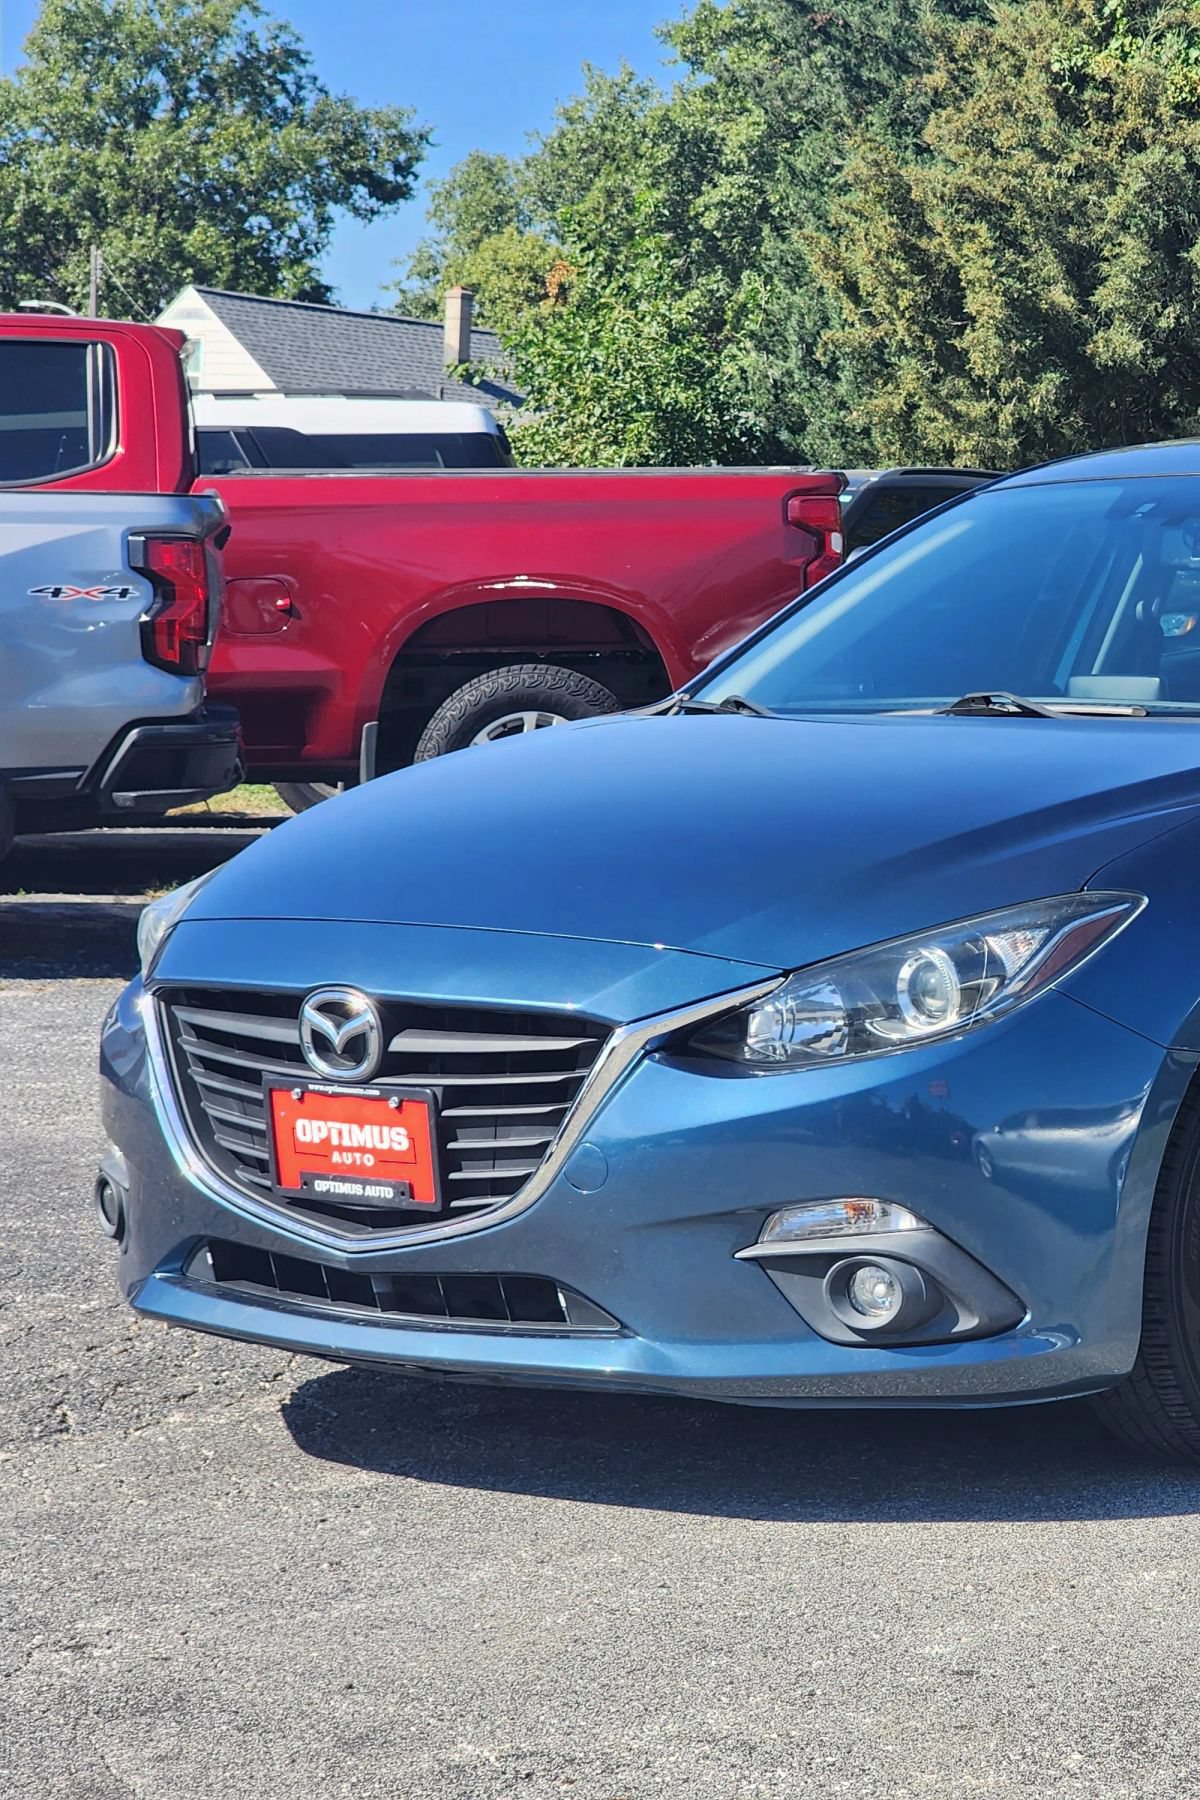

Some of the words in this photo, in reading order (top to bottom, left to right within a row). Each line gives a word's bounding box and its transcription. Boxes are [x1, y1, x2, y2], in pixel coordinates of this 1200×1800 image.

[295, 1118, 410, 1151] OPTIMUS
[331, 1151, 375, 1167] AUTO
[314, 1179, 363, 1196] OPTIMUS
[364, 1185, 394, 1199] AUTO
